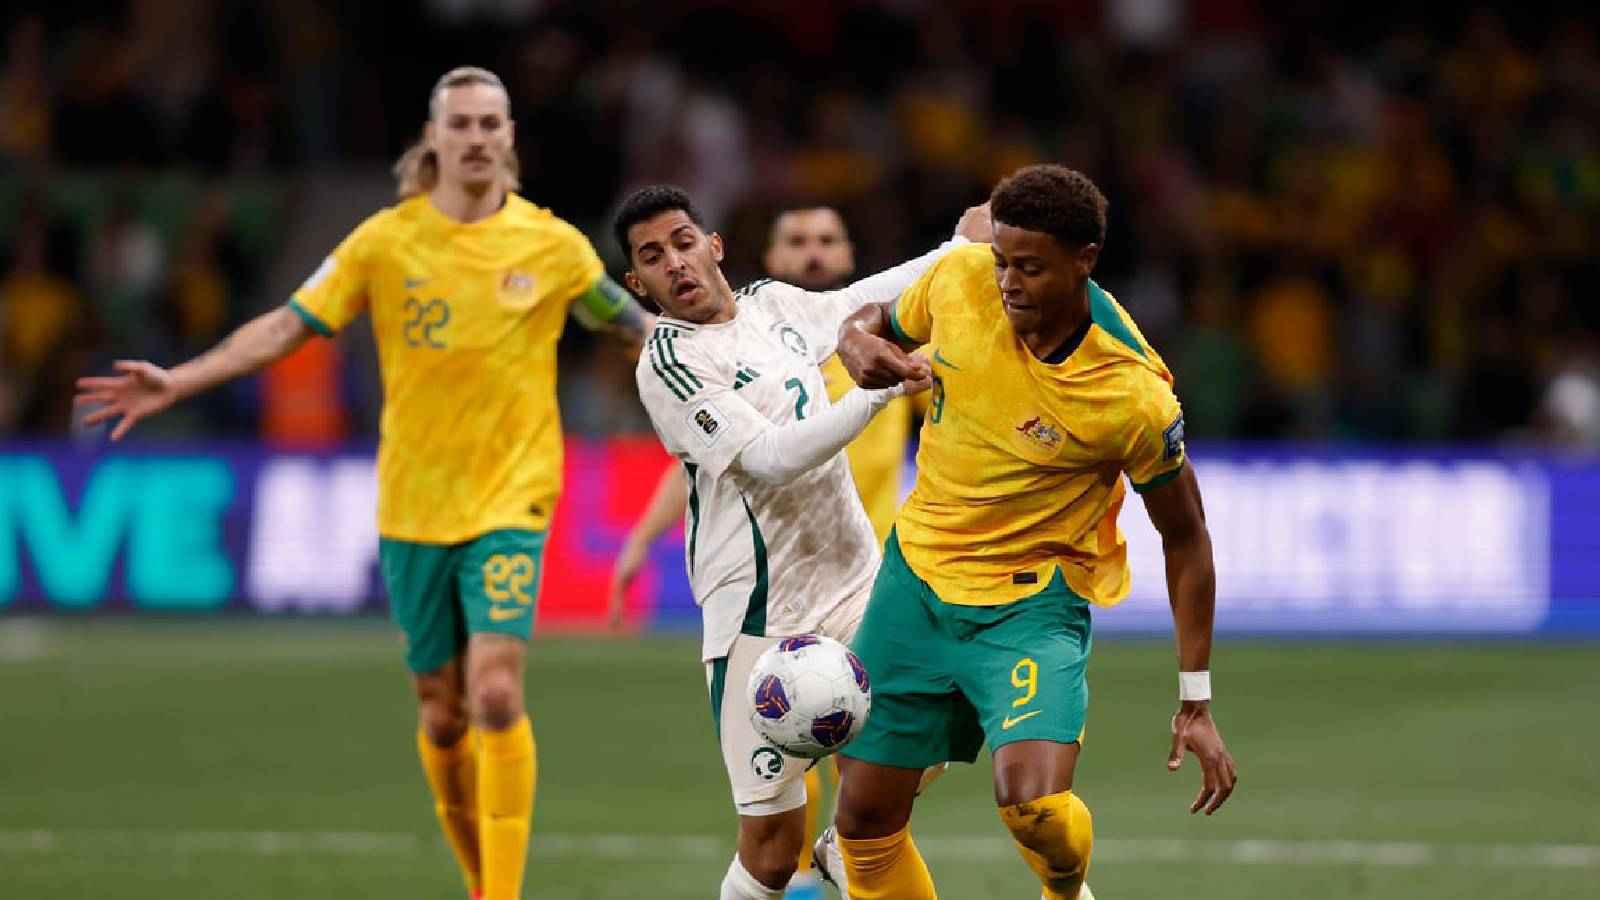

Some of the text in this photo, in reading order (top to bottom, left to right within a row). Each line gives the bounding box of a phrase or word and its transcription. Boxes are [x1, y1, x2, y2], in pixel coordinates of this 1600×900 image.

[403, 297, 451, 348] 22
[784, 377, 809, 422] 2
[483, 553, 535, 606] 22
[1010, 657, 1039, 708] 9
